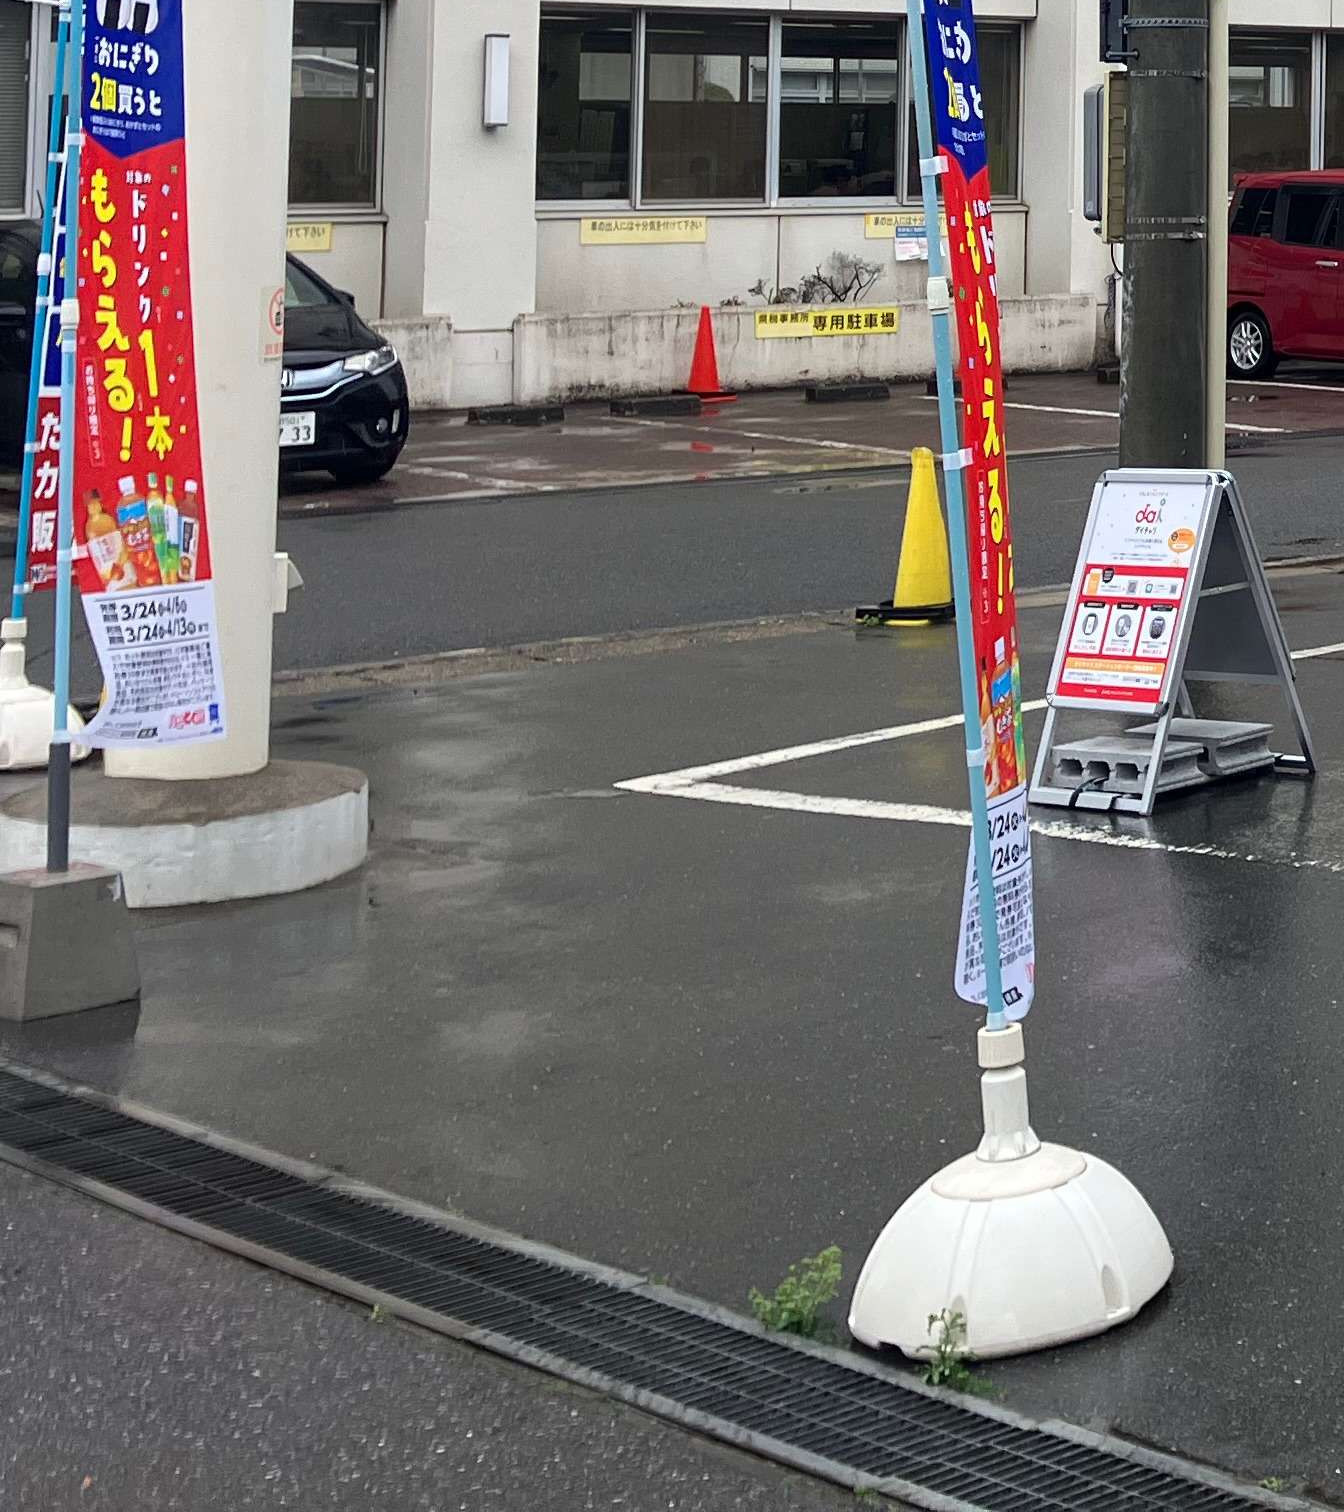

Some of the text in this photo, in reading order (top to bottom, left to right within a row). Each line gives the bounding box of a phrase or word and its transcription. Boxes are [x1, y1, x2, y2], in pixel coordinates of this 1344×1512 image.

[99, 36, 159, 76] おにぎり
[90, 71, 162, 117] 2個買うと
[813, 312, 895, 332] 専用駐車場
